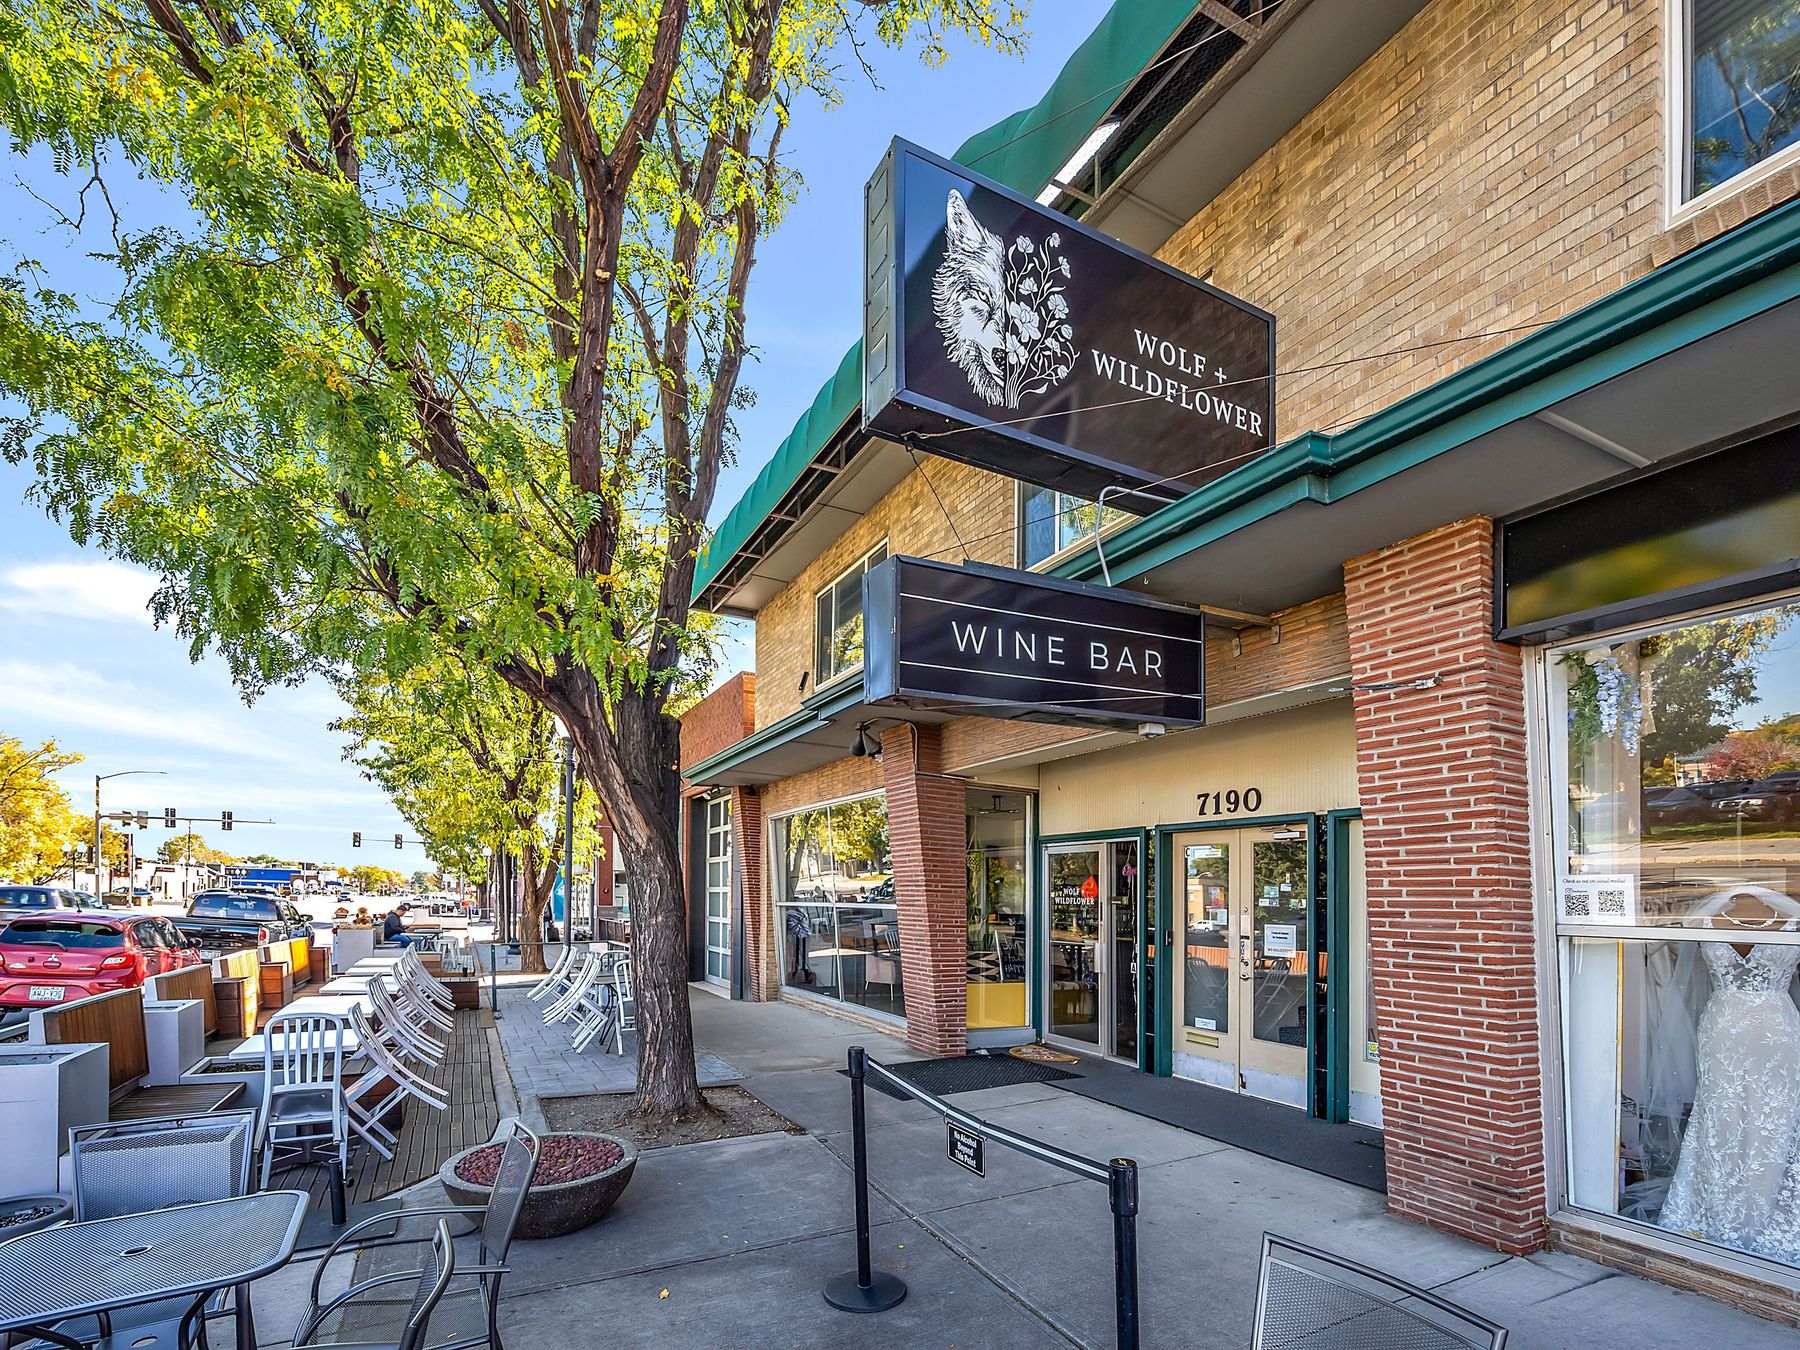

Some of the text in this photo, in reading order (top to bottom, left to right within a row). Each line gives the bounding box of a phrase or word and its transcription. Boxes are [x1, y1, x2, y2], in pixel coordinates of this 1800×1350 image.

[1134, 329, 1227, 384] WOLF +
[1091, 349, 1263, 437] WILDFLOWER
[951, 620, 1163, 678] WINE BAR
[1196, 787, 1263, 816] 7190
[1054, 896, 1095, 905] WILDFLOWER
[1063, 887, 1080, 896] WOLF
[954, 1130, 960, 1140] No
